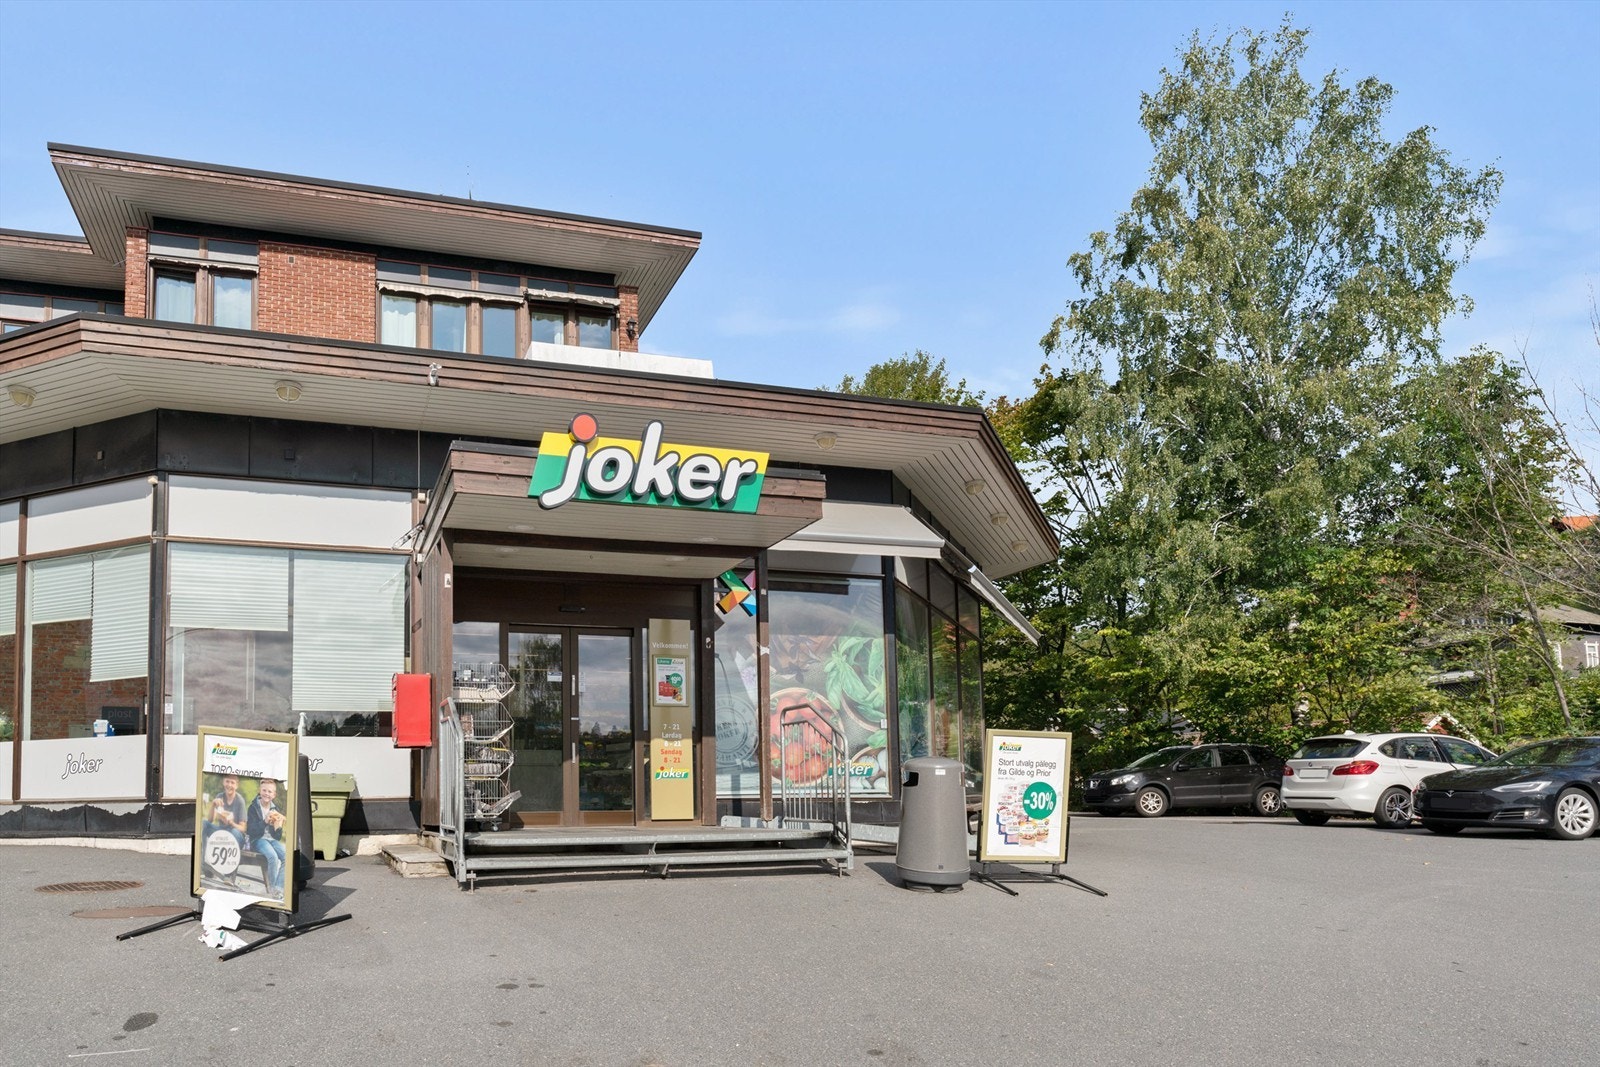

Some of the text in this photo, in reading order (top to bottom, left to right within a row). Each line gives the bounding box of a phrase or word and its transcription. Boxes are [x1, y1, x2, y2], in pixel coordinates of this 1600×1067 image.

[538, 412, 759, 509] joker
[212, 743, 236, 756] joker
[61, 751, 104, 780] joker
[998, 758, 1057, 769] Stort utvalg pålegg
[656, 765, 687, 780] joker
[1008, 768, 1026, 776] Gilde
[1036, 769, 1052, 777] Prior
[1023, 791, 1055, 811] -30%
